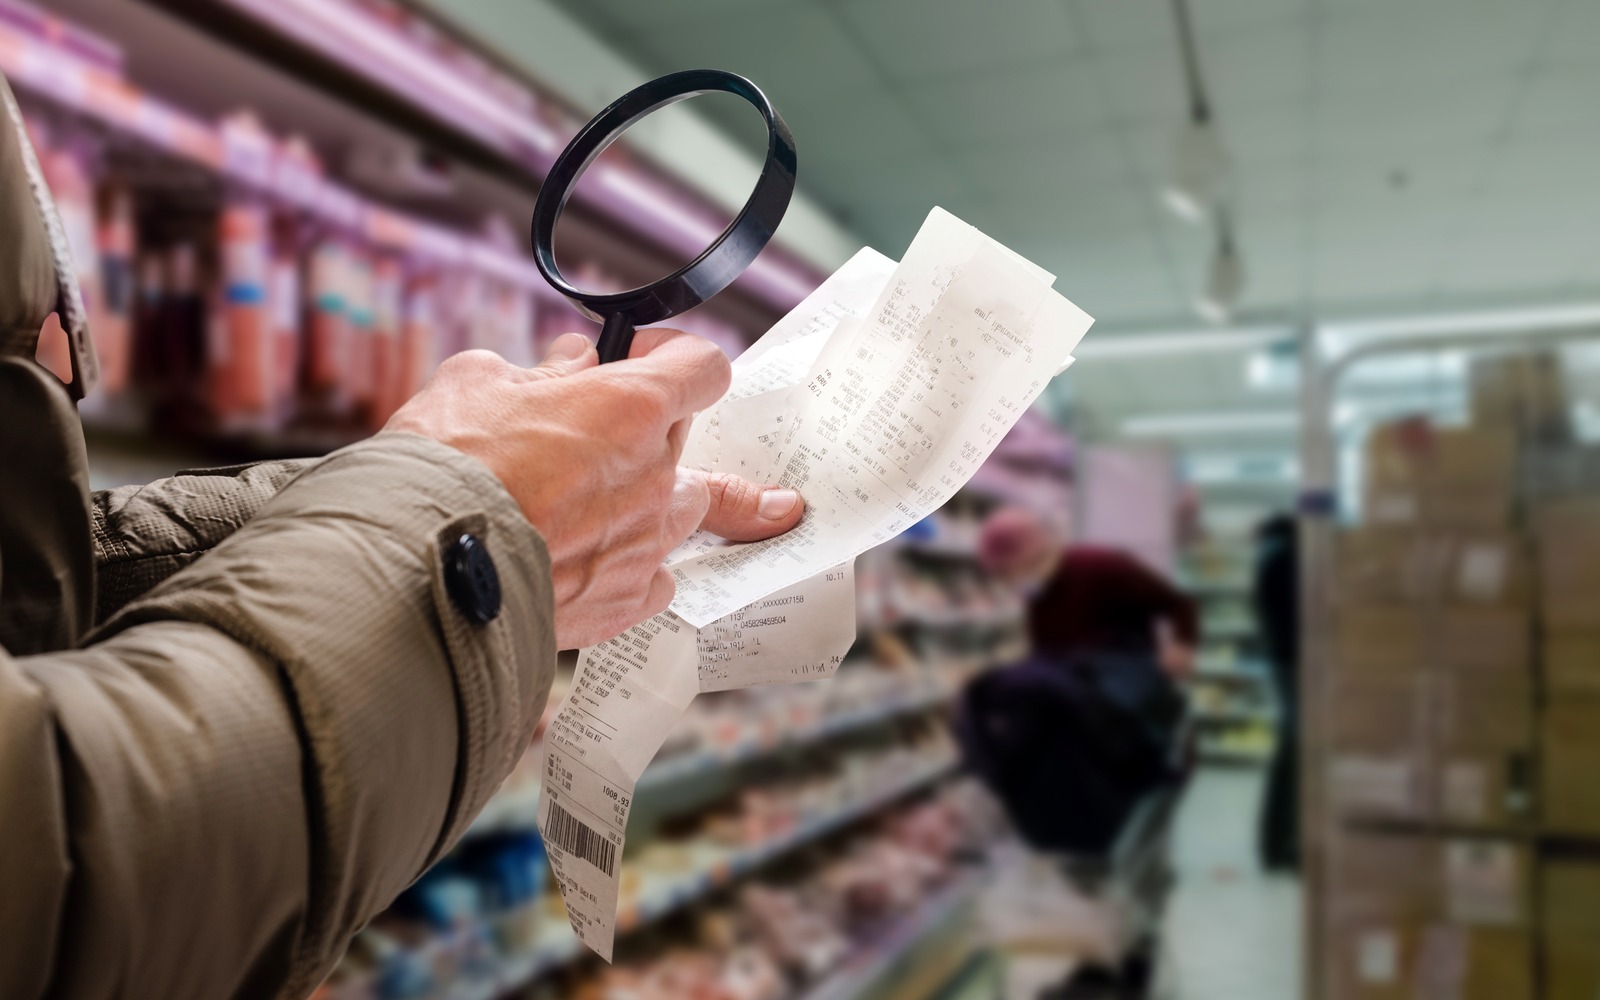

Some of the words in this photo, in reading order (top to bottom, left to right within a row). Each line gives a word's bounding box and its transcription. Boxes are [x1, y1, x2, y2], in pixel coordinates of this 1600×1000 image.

[825, 572, 844, 582] 10.11
[730, 612, 746, 622] 1137
[740, 616, 787, 629] 045829459504
[602, 785, 630, 808] 1008.93
